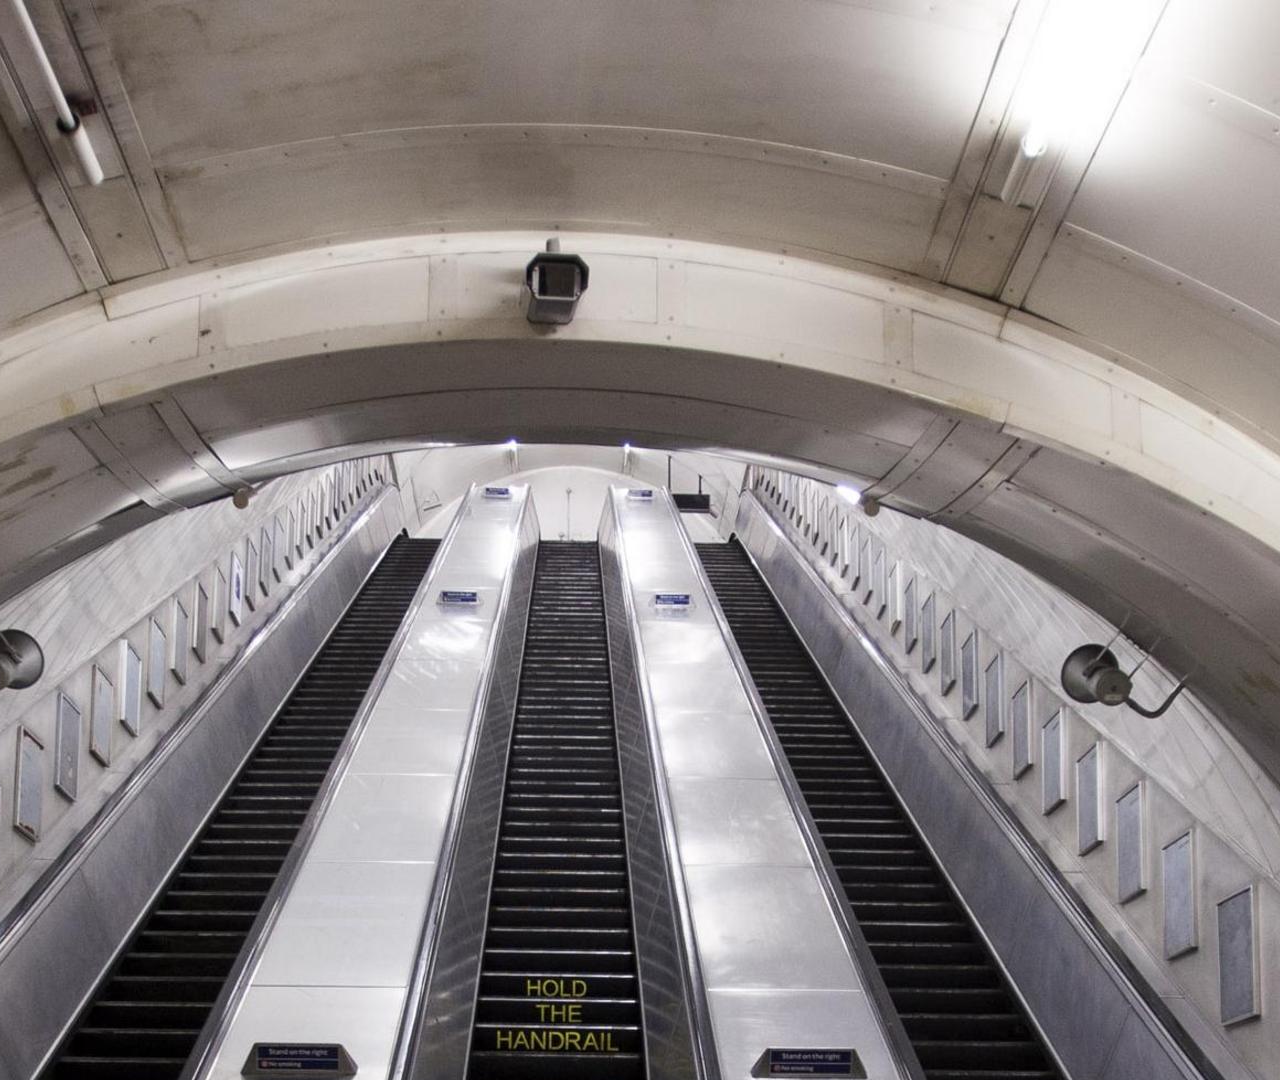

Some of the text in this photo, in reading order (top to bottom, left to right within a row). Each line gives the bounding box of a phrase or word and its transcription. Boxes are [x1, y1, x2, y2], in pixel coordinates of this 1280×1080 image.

[526, 979, 588, 998] HOLD
[535, 1004, 583, 1023] THE
[496, 1030, 620, 1051] HANDRAIL
